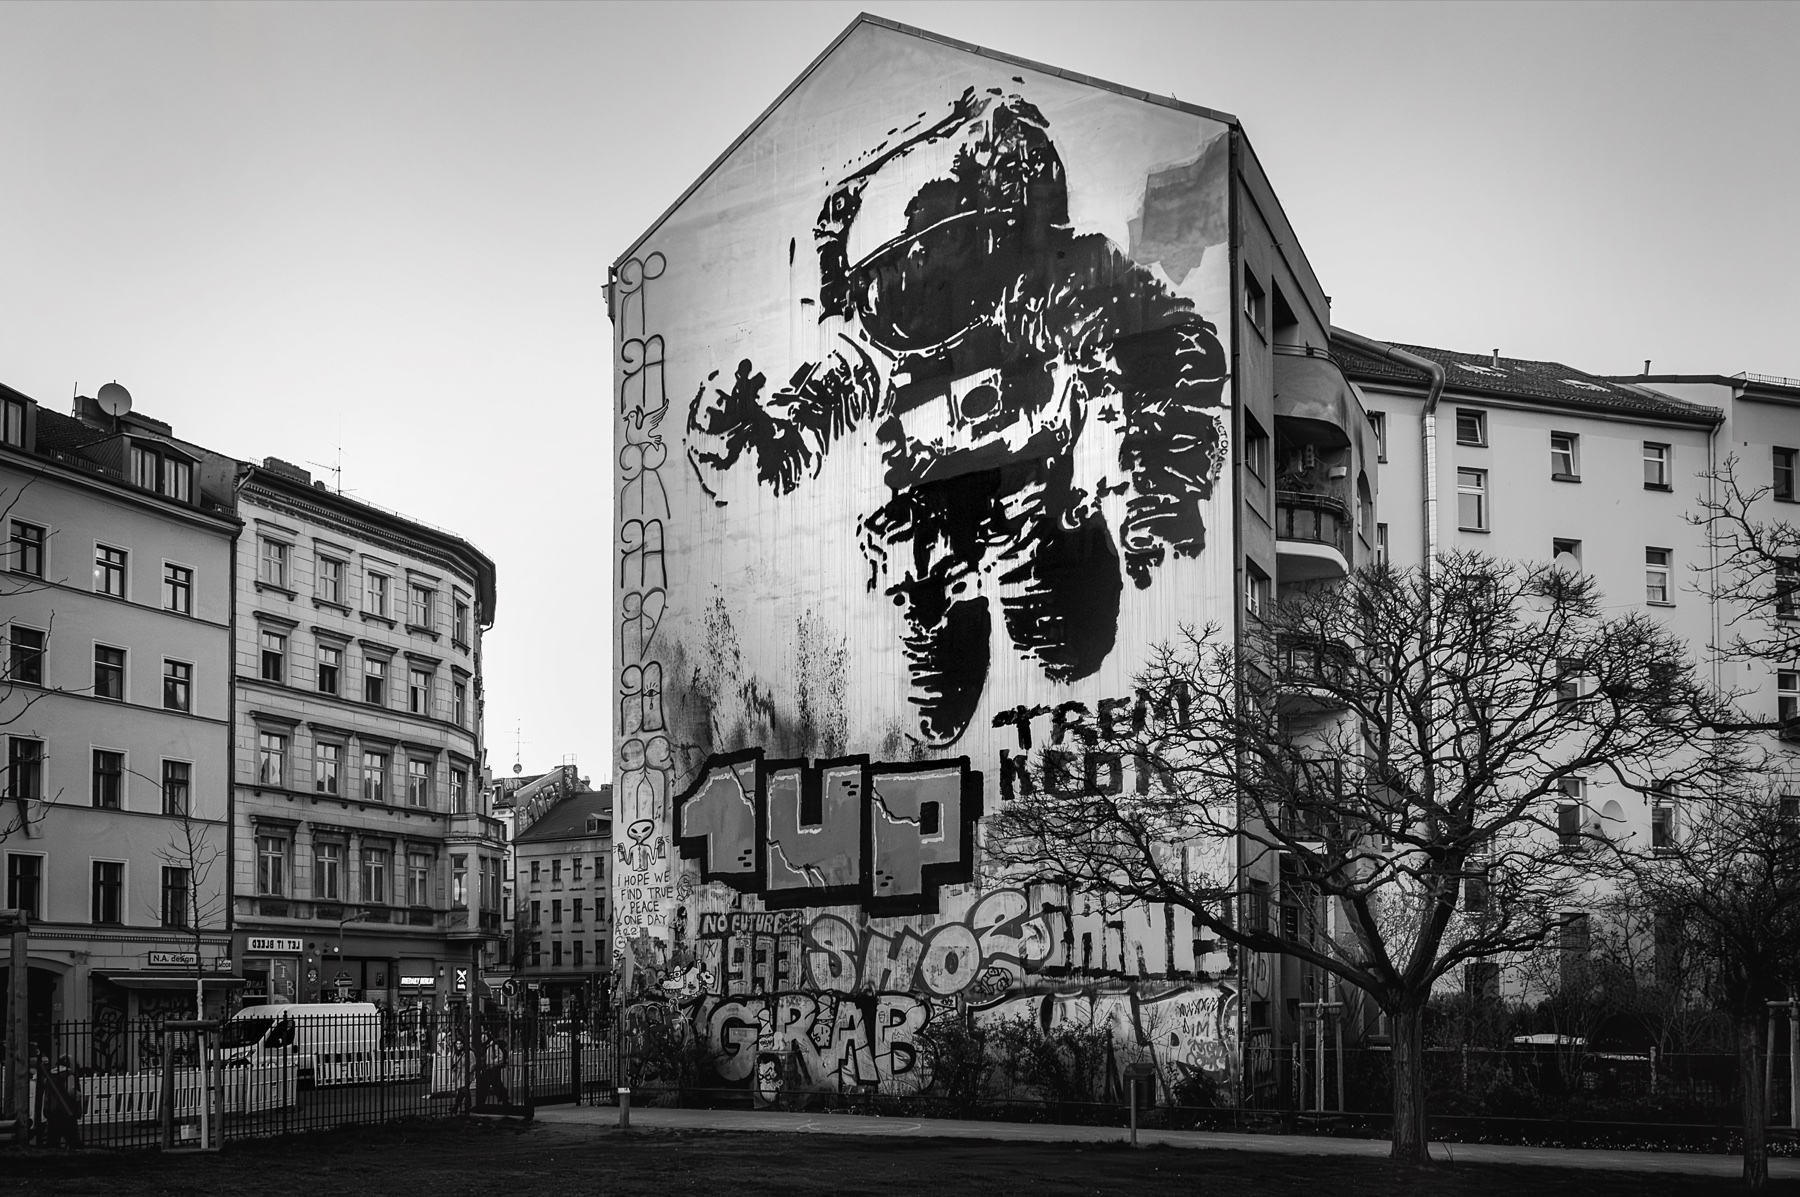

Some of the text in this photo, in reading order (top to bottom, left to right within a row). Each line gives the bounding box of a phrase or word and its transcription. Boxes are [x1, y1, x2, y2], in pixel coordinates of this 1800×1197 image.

[674, 749, 980, 915] 1UP
[624, 872, 650, 886] HOPE
[653, 871, 670, 883] WE
[647, 886, 673, 899] TRUE
[629, 901, 660, 914] PEACE
[623, 914, 668, 926] ONE DAY
[702, 913, 729, 934] NO
